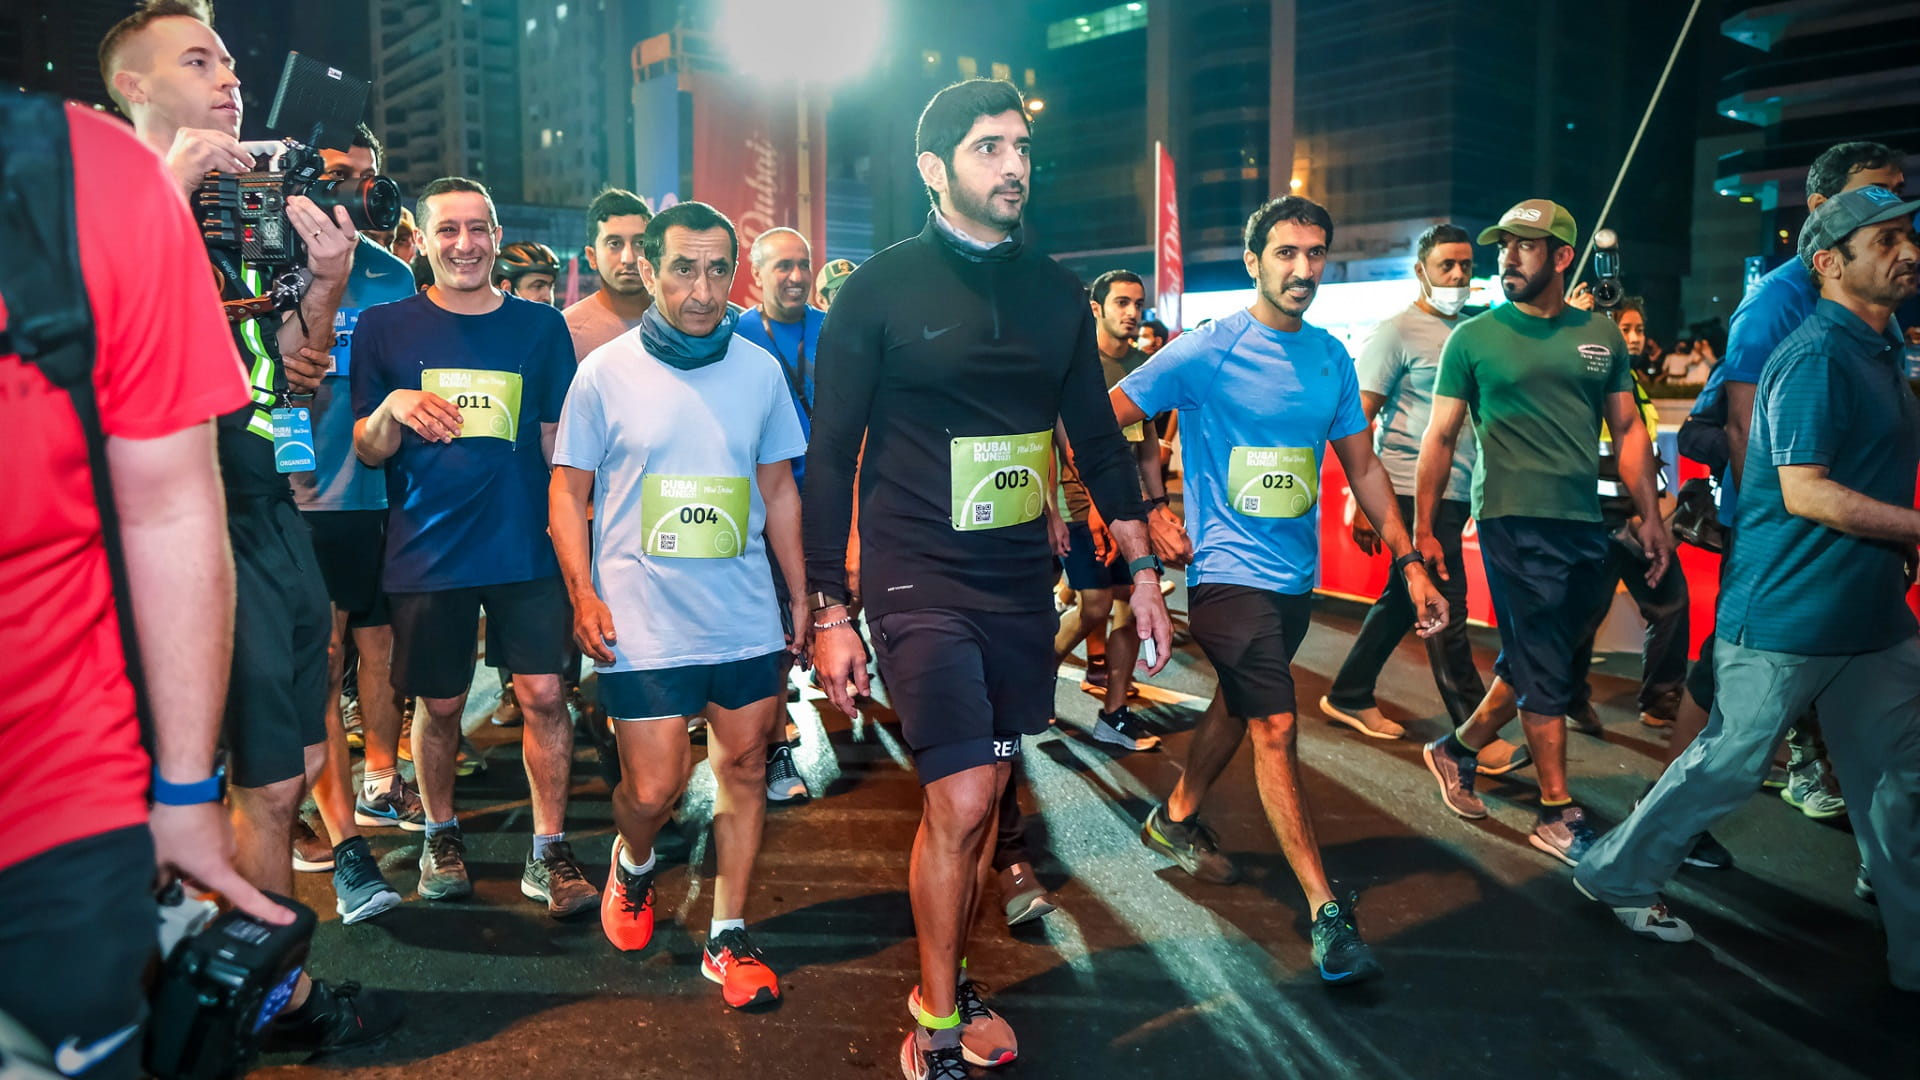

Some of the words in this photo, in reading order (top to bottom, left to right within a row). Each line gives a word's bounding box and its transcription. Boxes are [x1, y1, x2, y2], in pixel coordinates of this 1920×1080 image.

[738, 136, 777, 249] Dubai
[457, 395, 491, 408] 011
[973, 441, 1011, 453] DUBAI
[973, 452, 999, 462] RUN
[1247, 451, 1278, 459] DUBAI
[660, 479, 697, 489] DUBAI
[995, 469, 1029, 490] 003
[1262, 474, 1294, 489] 023
[660, 488, 682, 497] RUN
[680, 507, 718, 524] 004
